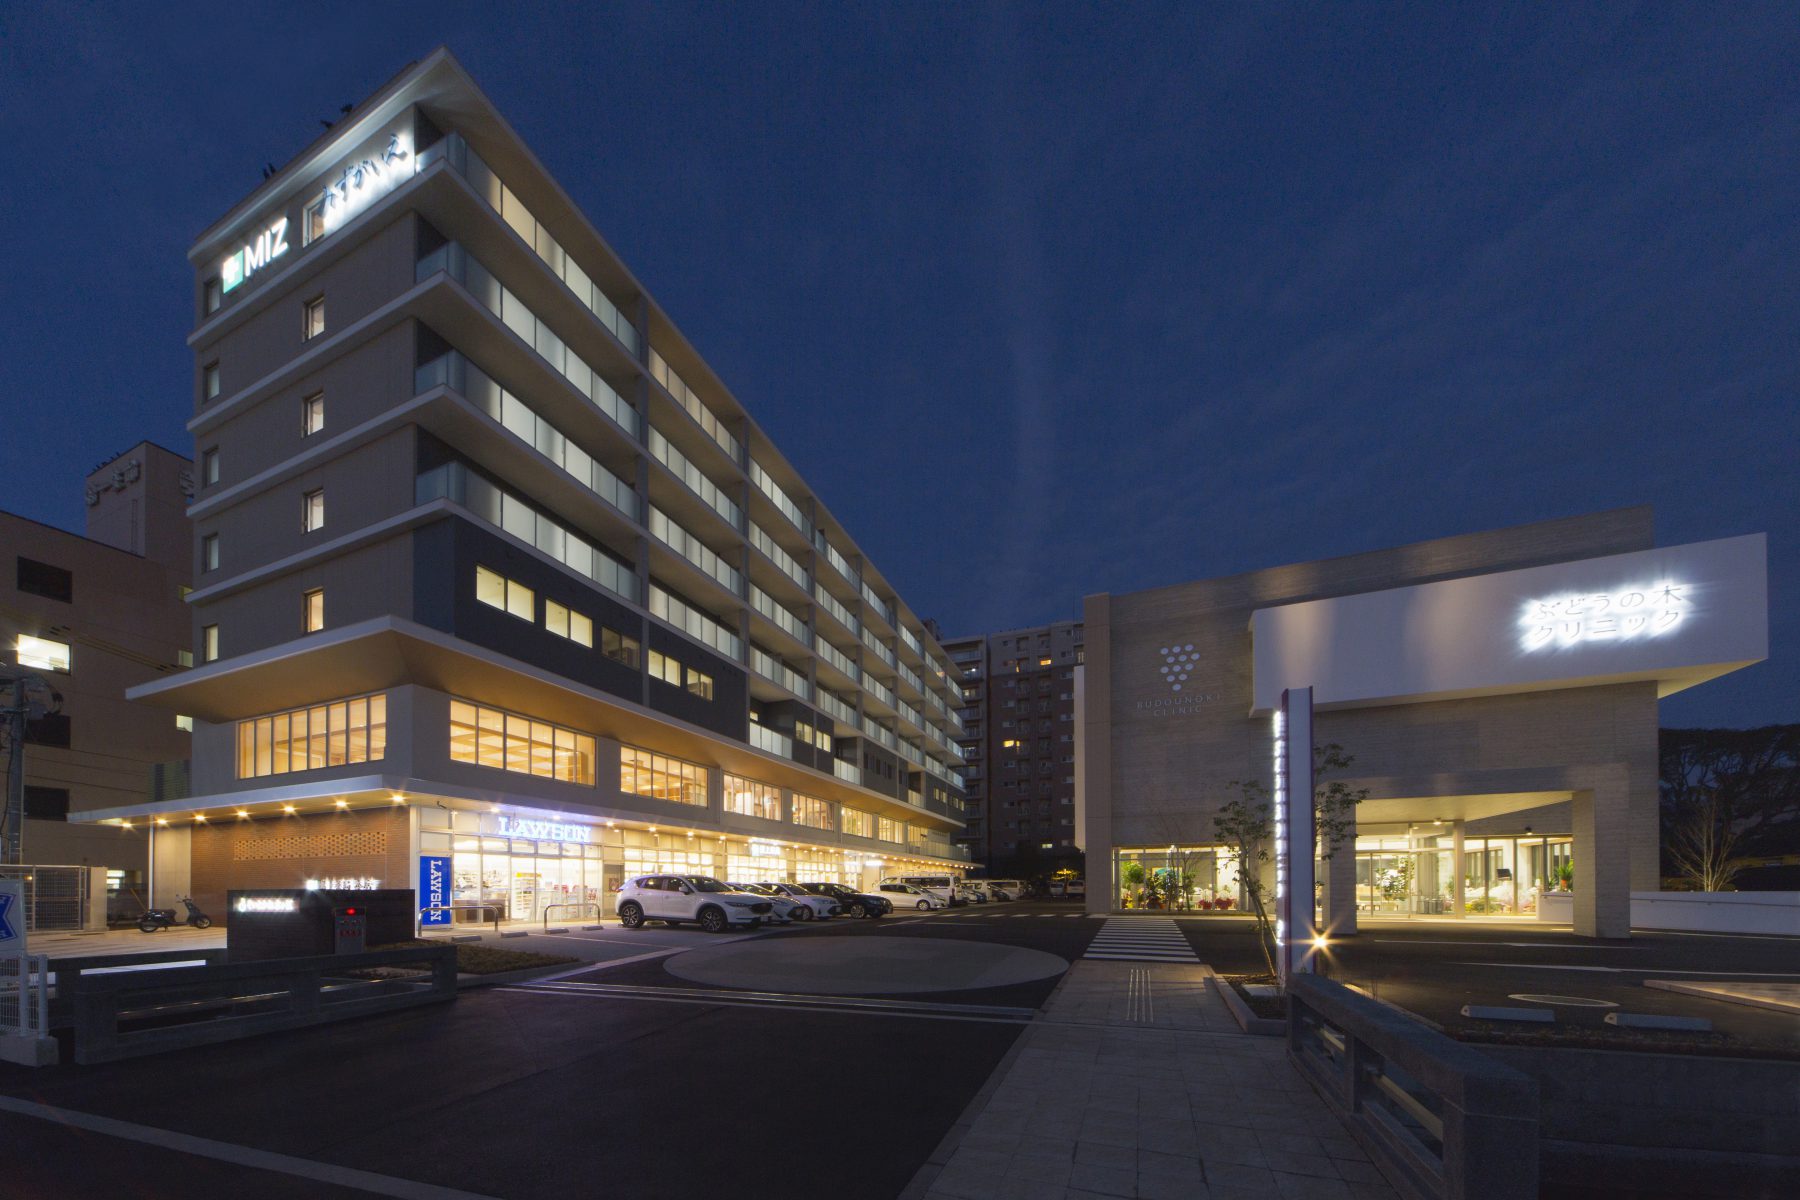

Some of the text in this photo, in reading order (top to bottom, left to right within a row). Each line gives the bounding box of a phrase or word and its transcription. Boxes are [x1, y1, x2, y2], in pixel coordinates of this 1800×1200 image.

[317, 133, 408, 216] みずがえ
[244, 217, 288, 277] MIZ
[1536, 585, 1682, 620] ぶどうの木
[1533, 610, 1679, 643] クリニック
[1153, 704, 1202, 718] CLINIC
[498, 816, 592, 843] LAWSON
[430, 860, 442, 922] LAWSON
